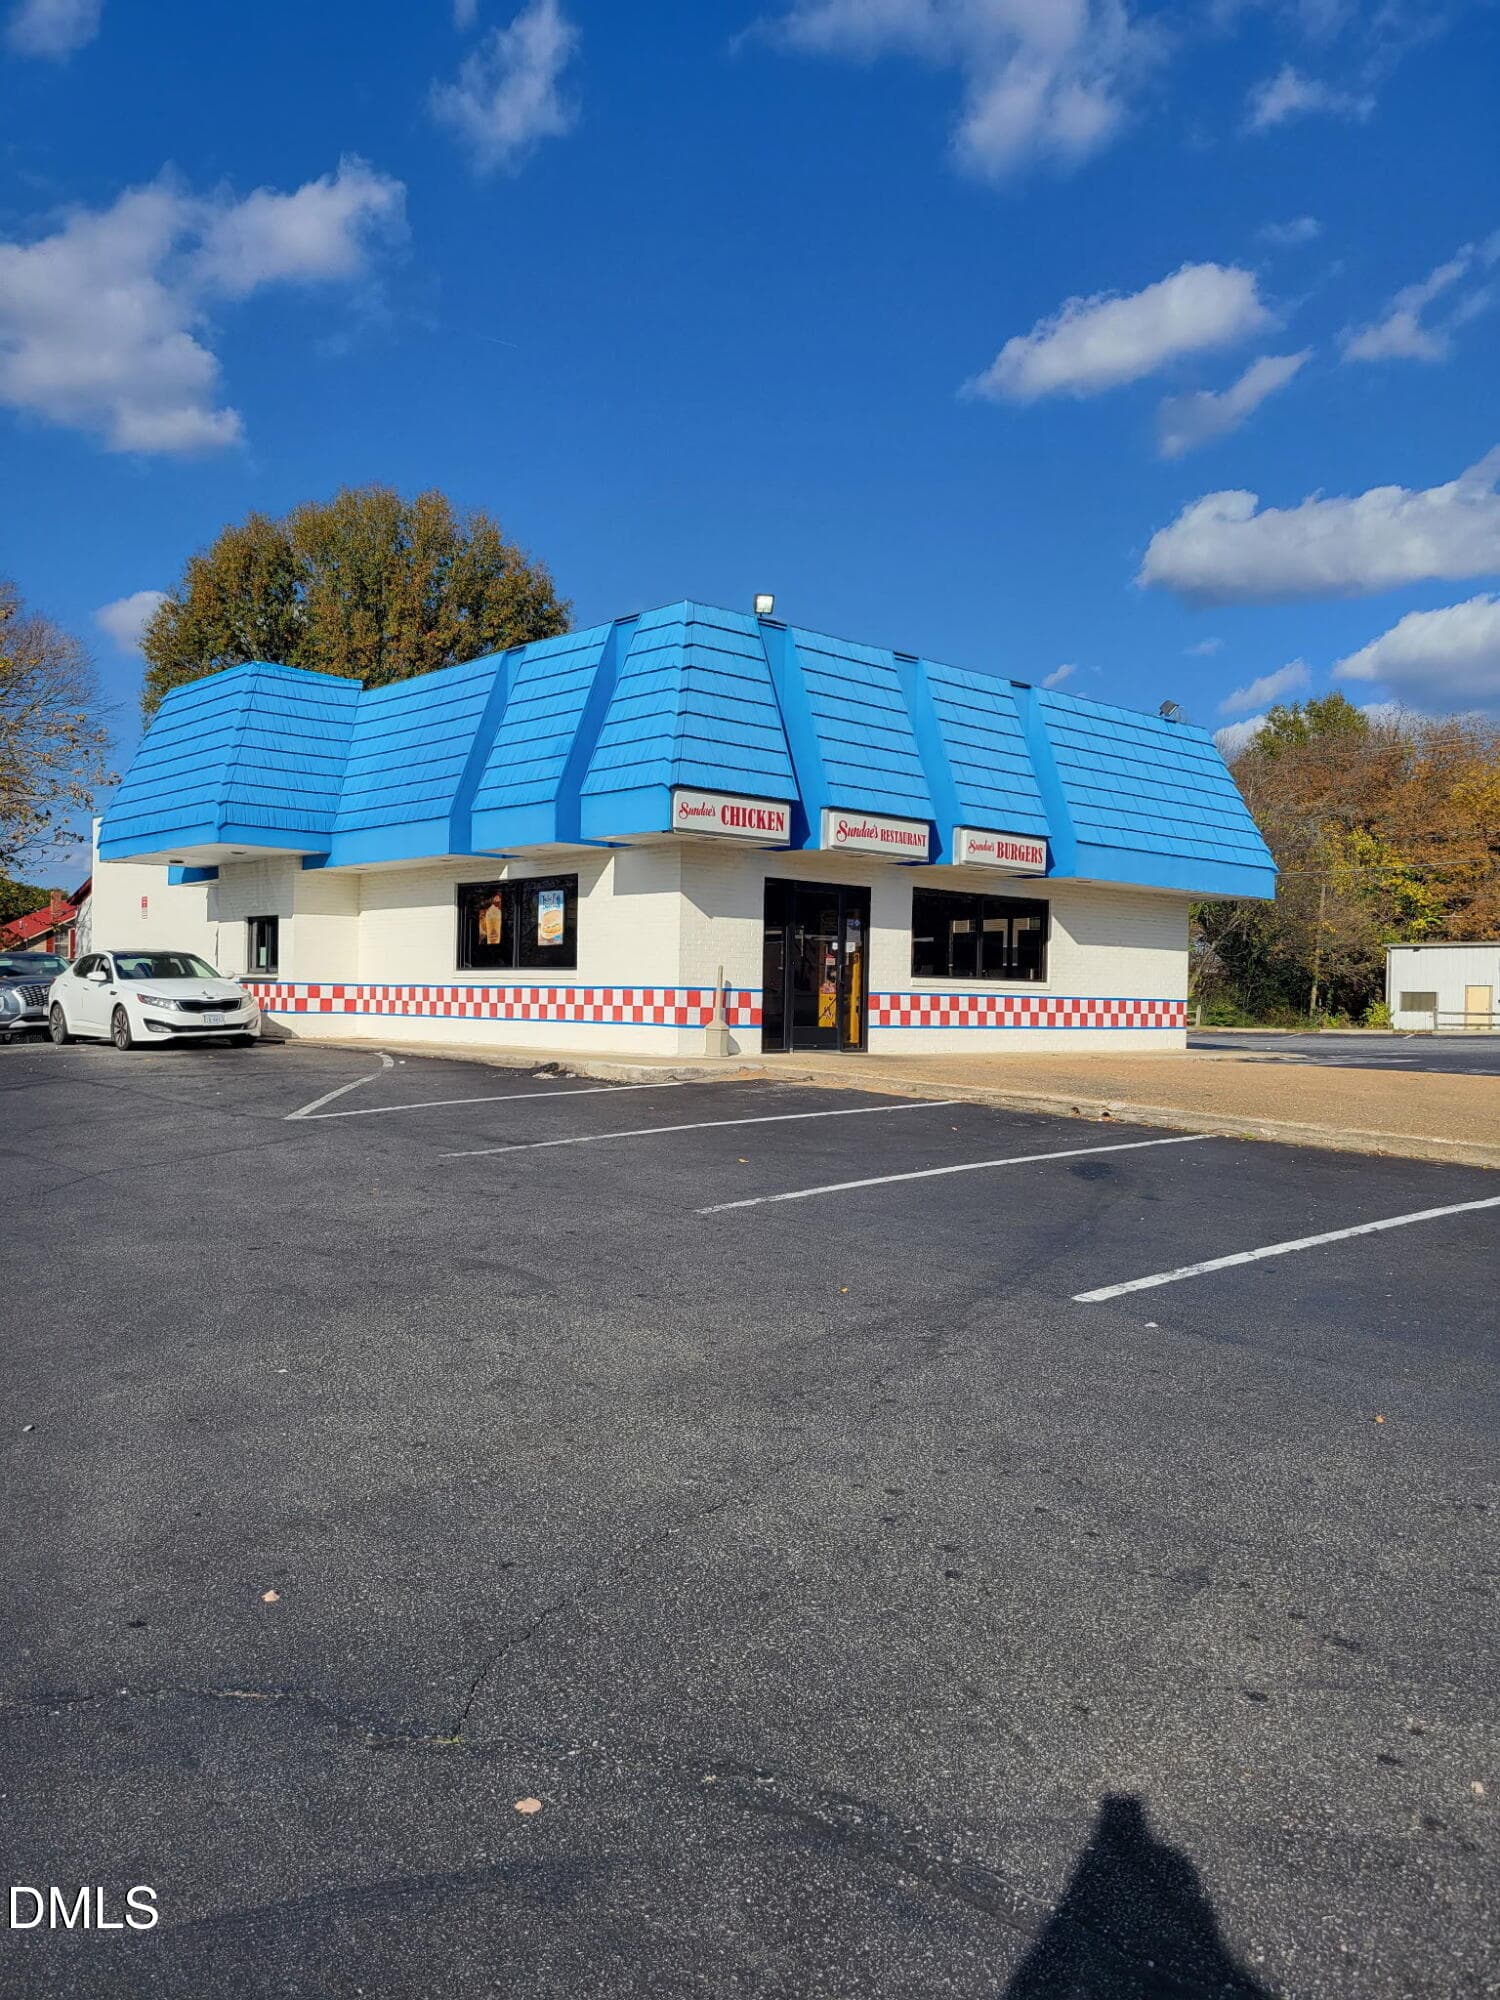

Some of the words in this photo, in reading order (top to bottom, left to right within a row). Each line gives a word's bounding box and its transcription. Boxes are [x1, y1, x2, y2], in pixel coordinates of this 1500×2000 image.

[679, 801, 716, 820] Sundae's
[720, 804, 785, 832] CHICKEN
[836, 819, 878, 842] Sundae's
[880, 828, 927, 847] RESTAURANT
[996, 841, 1043, 864] BURGERS
